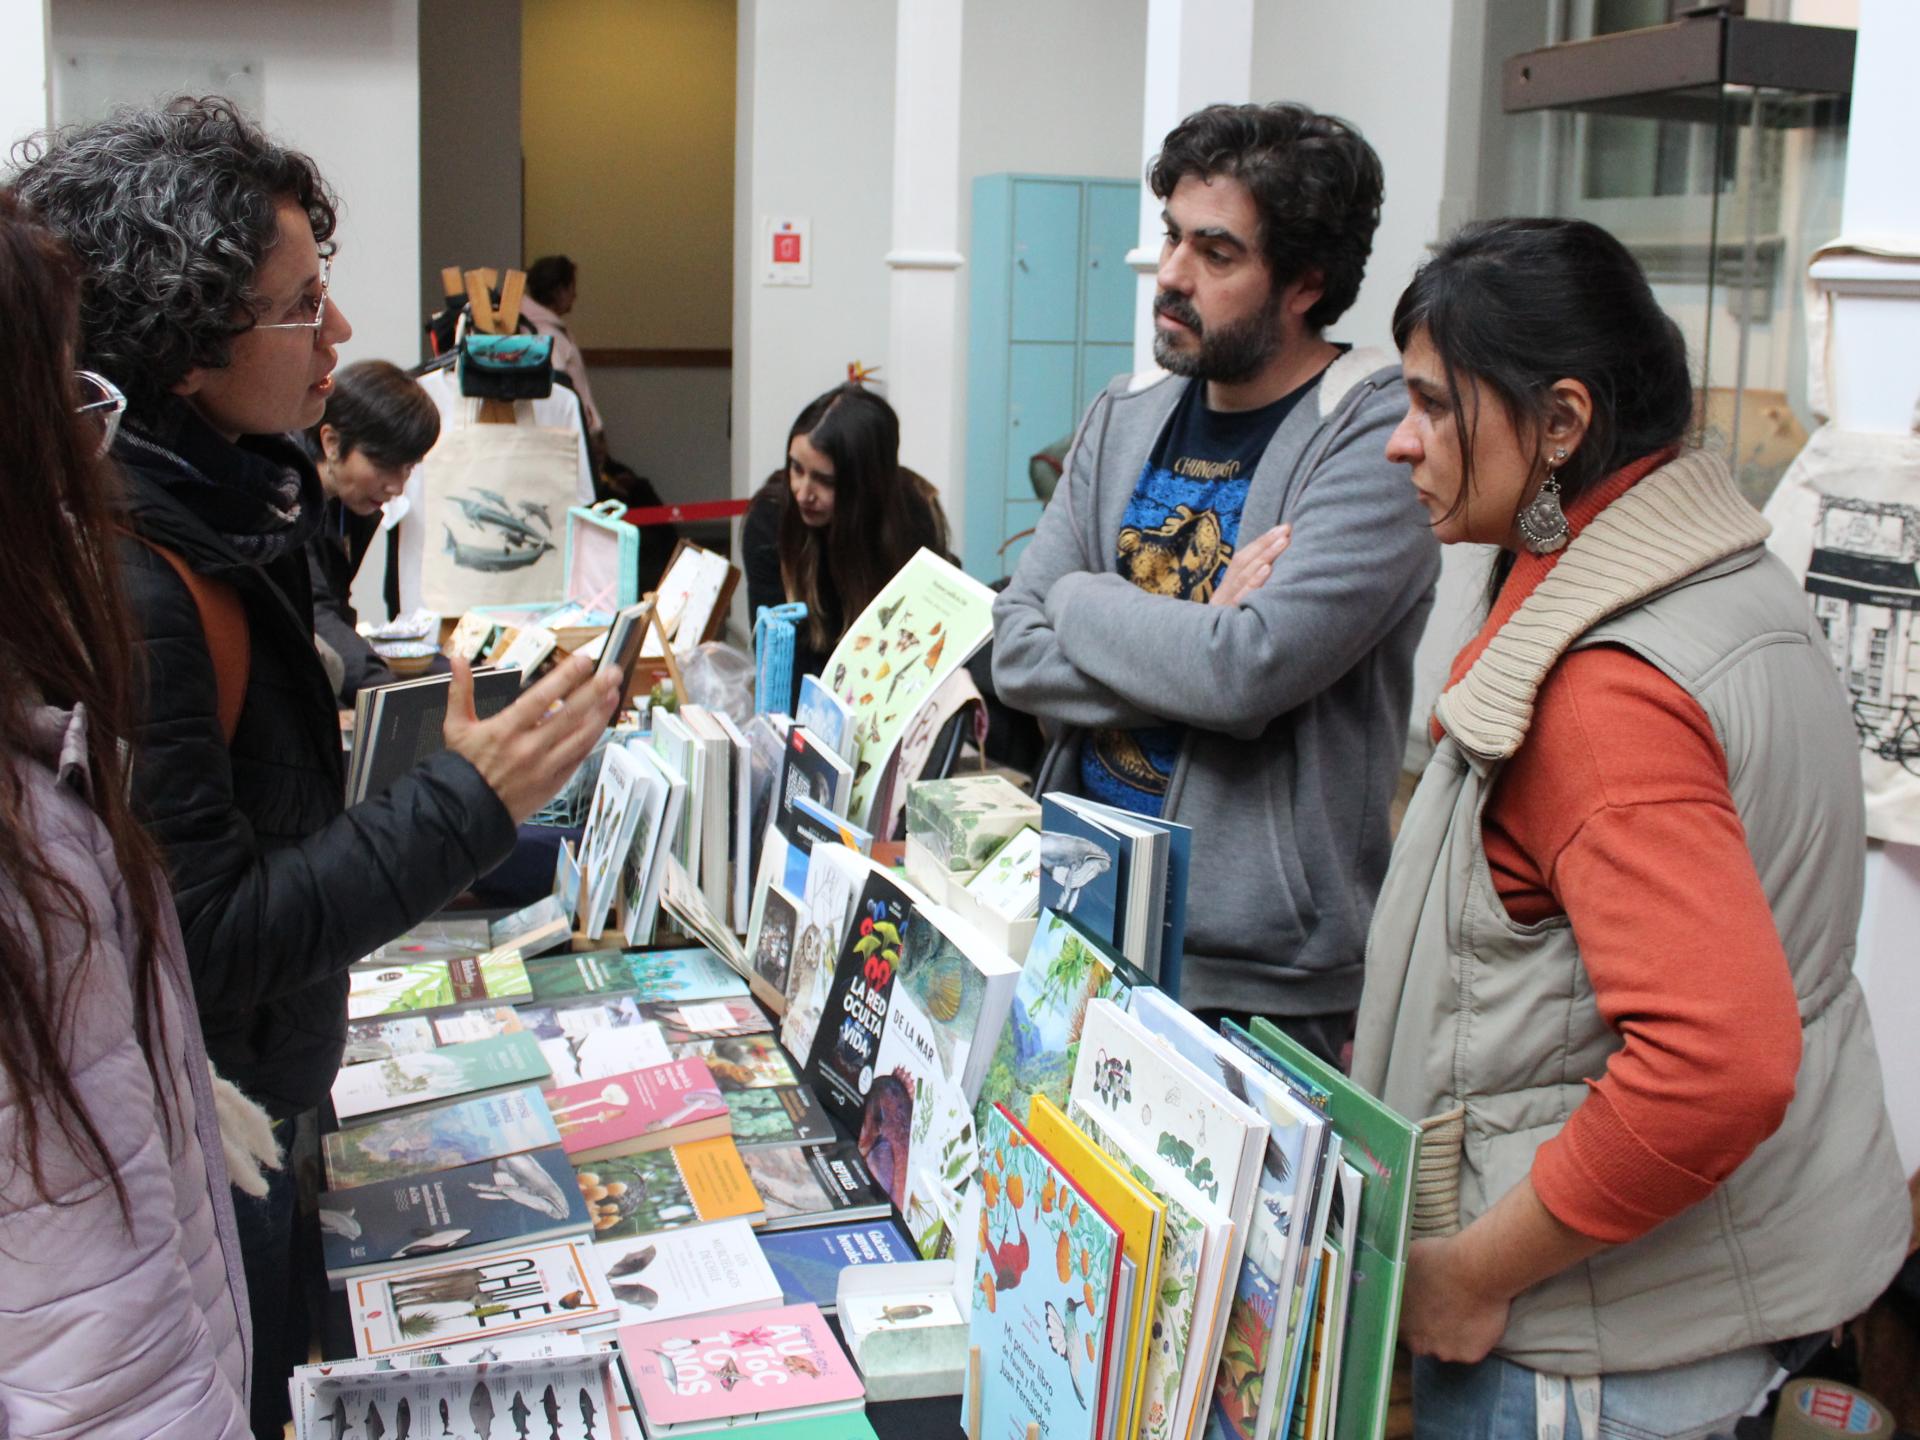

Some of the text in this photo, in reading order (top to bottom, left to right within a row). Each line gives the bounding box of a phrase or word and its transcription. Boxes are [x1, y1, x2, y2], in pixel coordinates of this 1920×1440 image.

[843, 994, 882, 1039] OCULTA
[850, 976, 887, 1017] LA RED
[844, 1021, 869, 1059] VIDA
[893, 1008, 935, 1064] DE LA MAR
[476, 1258, 552, 1327] CHILE
[1002, 1343, 1009, 1359] de
[1009, 1351, 1025, 1380] fauna
[1030, 1380, 1043, 1405] flora
[1044, 1400, 1051, 1416] de
[1004, 1321, 1013, 1342] Mi
[1014, 1339, 1036, 1373] primer
[1037, 1365, 1053, 1397] libro
[1000, 1359, 1015, 1389] Juan
[1016, 1380, 1050, 1437] Fernández
